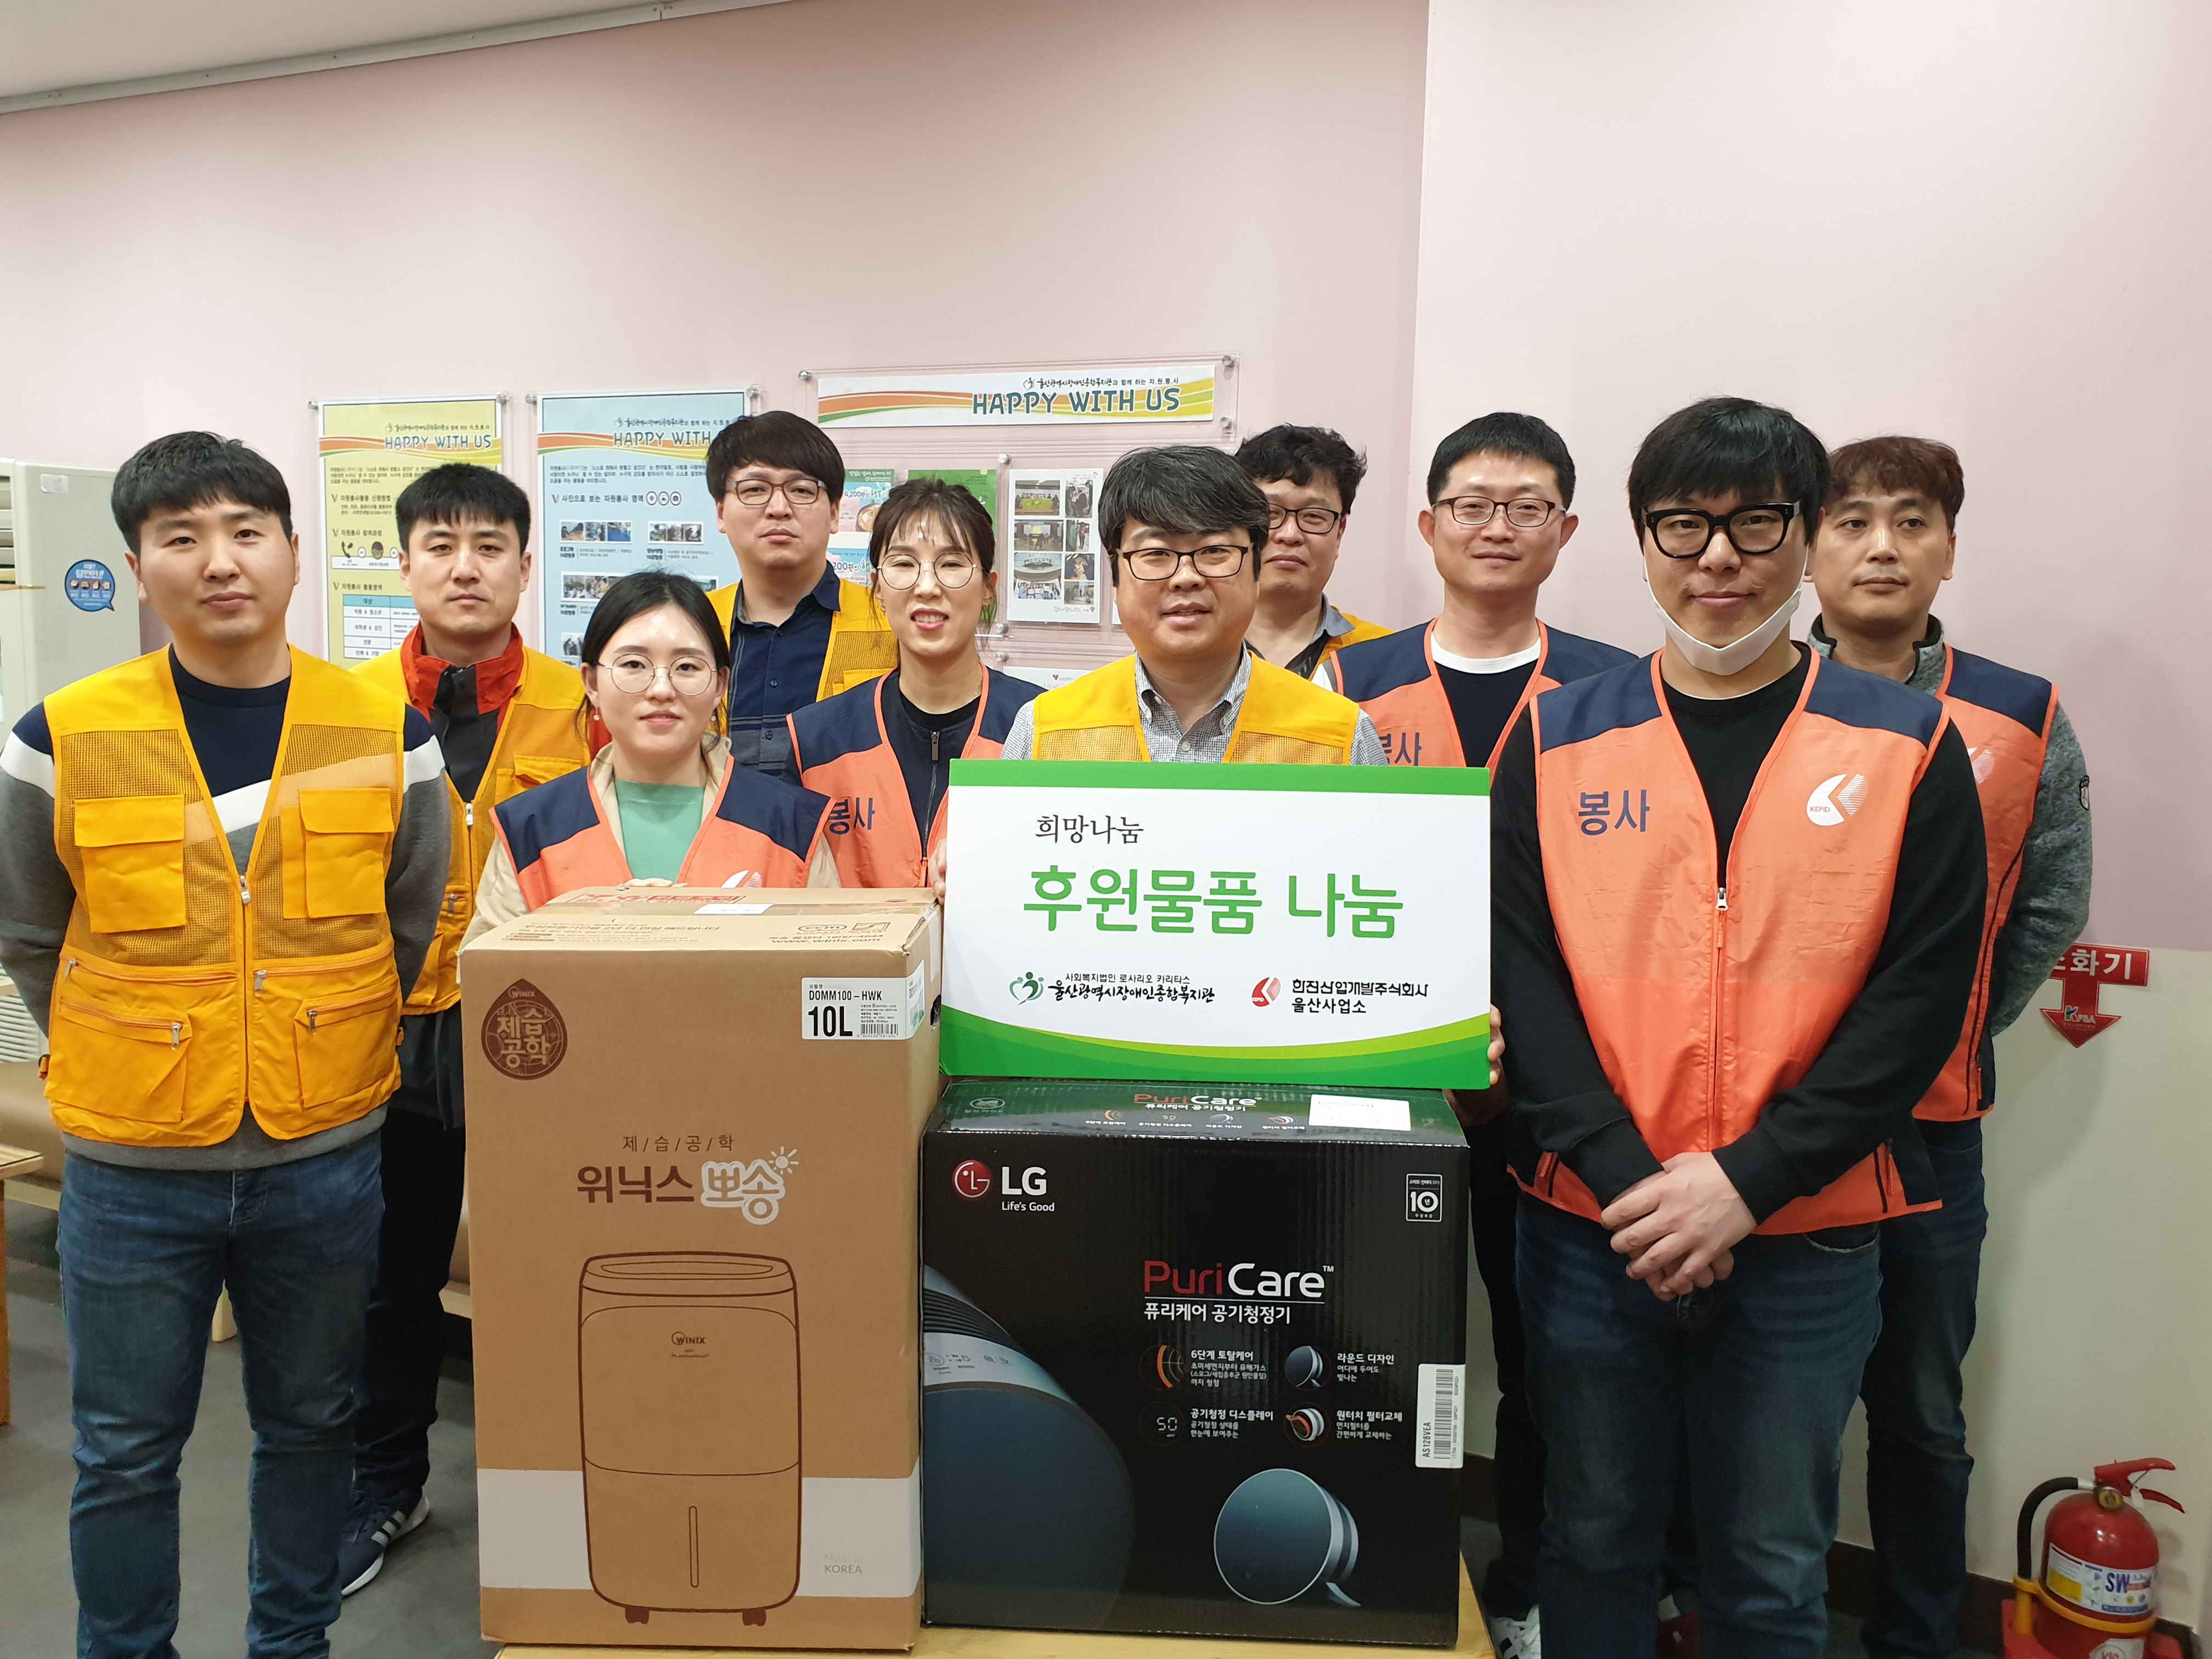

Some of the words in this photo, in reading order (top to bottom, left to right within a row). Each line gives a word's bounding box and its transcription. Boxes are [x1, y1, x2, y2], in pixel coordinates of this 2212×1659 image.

[973, 391, 1057, 415] HAPPY
[1069, 389, 1135, 413] WITH
[1146, 388, 1180, 411] US
[385, 436, 428, 449] HAPPY
[435, 435, 469, 448] WITH
[475, 435, 491, 448] US
[614, 431, 664, 446] HAPPY
[672, 431, 711, 445] WITH
[562, 494, 585, 503] 사진으로
[828, 797, 876, 835] 봉사
[1578, 789, 1650, 836] 봉사
[1035, 814, 1144, 845] 희망나눔
[1023, 865, 1262, 934] 후원물품
[1288, 873, 1403, 939] 나눔
[1065, 973, 1116, 983] 사회복지법인
[1119, 974, 1153, 984] 로사리오
[1156, 974, 1190, 984] 카리타스
[1047, 980, 1215, 1005] 울산광역시장애인종합복지관
[1292, 979, 1429, 997] 한진산업개발주식회사
[1291, 997, 1367, 1014] 울산사업소
[808, 1006, 853, 1037] 10L
[1133, 1093, 1257, 1105] PuriCare
[1002, 1166, 1047, 1196] LG
[577, 1165, 695, 1204] 위닉스
[701, 1159, 786, 1225] 뽀송
[1002, 1201, 1026, 1211] Life's
[1029, 1201, 1055, 1212] Good
[1410, 1191, 1438, 1212] 10
[1144, 1260, 1325, 1298] PuriCare
[1144, 1302, 1206, 1322] 퓨리케어
[1211, 1304, 1290, 1324] 공기청정기
[1191, 1350, 1215, 1360] 6단계
[1217, 1351, 1254, 1361] 토탈케어
[1337, 1353, 1364, 1364] 라운드
[1367, 1354, 1394, 1364] 디자인
[1190, 1362, 1238, 1371] 초미세먼지부터
[1337, 1374, 1358, 1382] 빛나는
[1190, 1408, 1226, 1420] 공기청정
[1229, 1409, 1273, 1421] 디스플레이
[1336, 1410, 1363, 1421] 원터치
[1367, 1411, 1403, 1422] 필터교체
[1190, 1420, 1217, 1429] 공기청정
[1212, 1430, 1239, 1438] 보여주는
[1336, 1431, 1363, 1439] 간편하게
[1422, 1421, 1431, 1458] AS128VEA
[825, 1565, 862, 1573] KOREA
